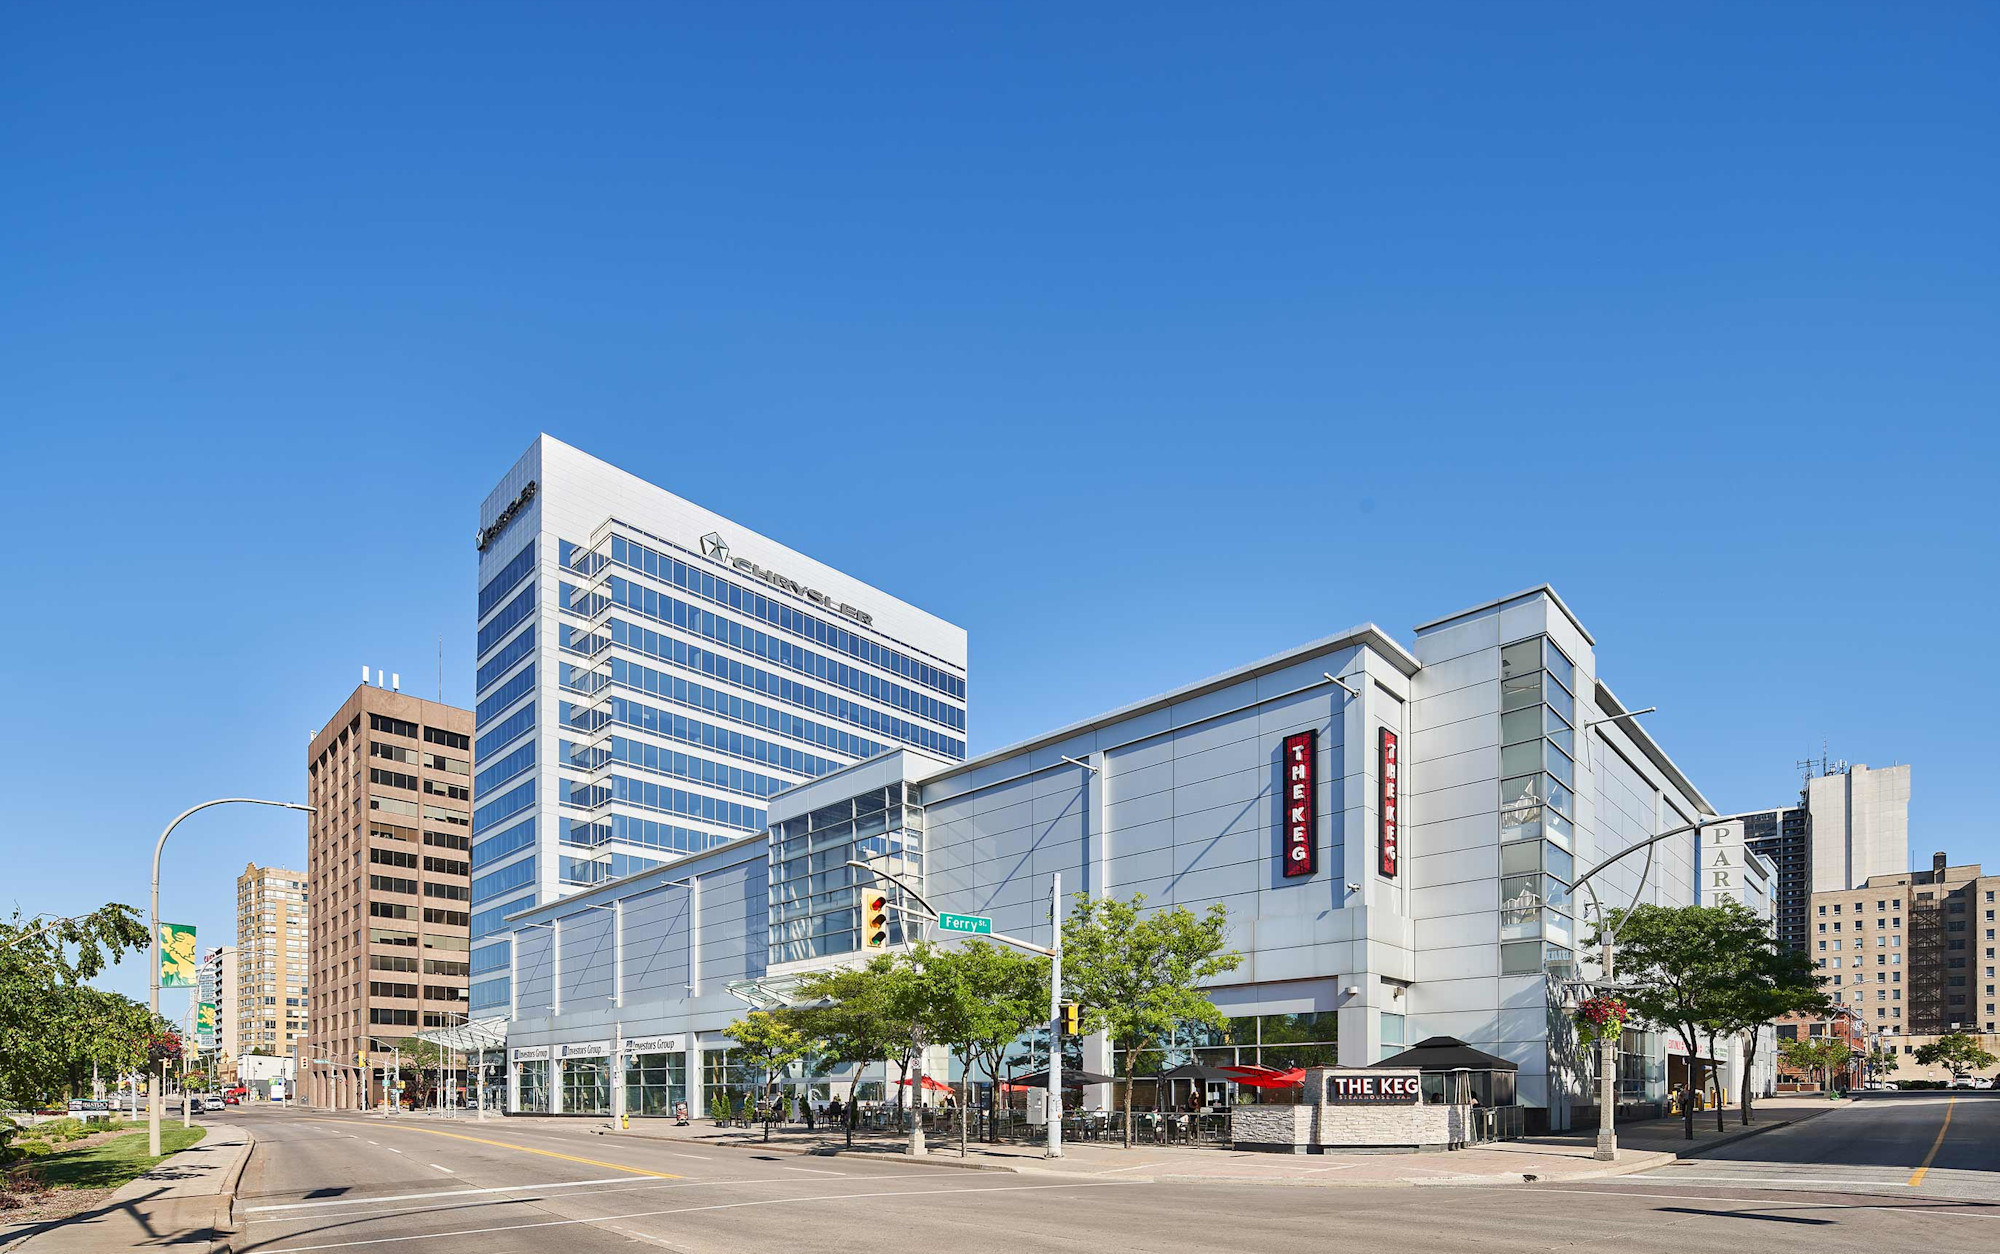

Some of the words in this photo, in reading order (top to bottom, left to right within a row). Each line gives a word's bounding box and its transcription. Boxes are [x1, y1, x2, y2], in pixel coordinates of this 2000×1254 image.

[732, 557, 873, 627] CHRYSLER
[1292, 745, 1305, 800] THE
[1386, 743, 1396, 799] THE
[1291, 806, 1306, 861] KEG
[1386, 805, 1396, 860] KEG
[946, 916, 977, 933] Ferry
[519, 1049, 536, 1059] Investors
[536, 1048, 548, 1058] Group
[567, 1045, 587, 1056] Investors
[587, 1044, 601, 1055] Group
[632, 1041, 657, 1051] Investors
[657, 1039, 675, 1050] Group
[1335, 1078, 1373, 1094] THE
[1381, 1078, 1418, 1094] KEG
